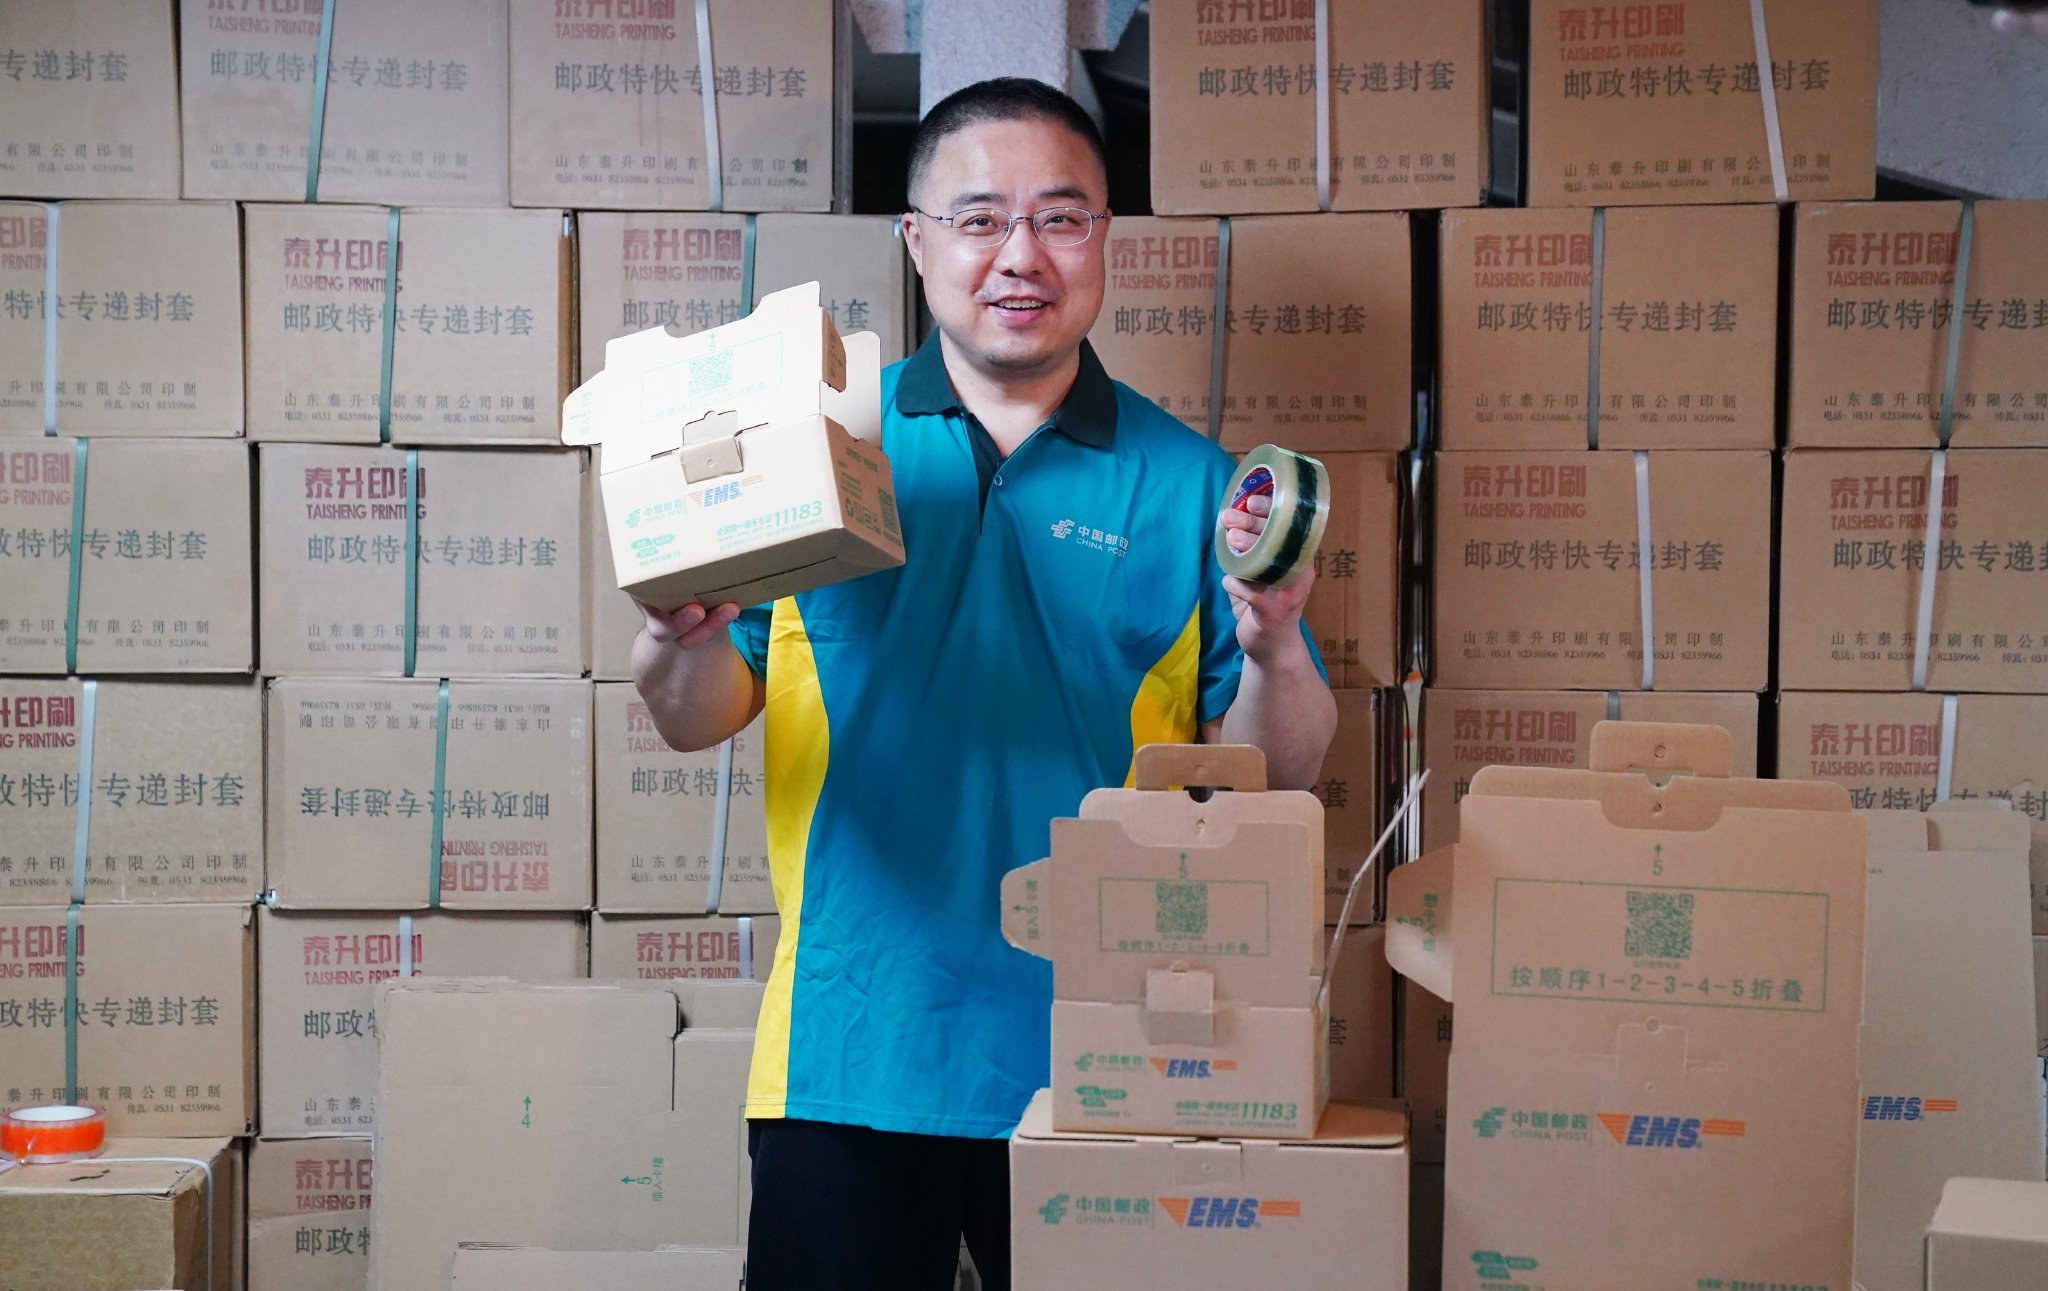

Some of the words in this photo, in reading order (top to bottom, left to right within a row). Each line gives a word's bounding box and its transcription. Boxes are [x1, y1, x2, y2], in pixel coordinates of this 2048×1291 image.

[274, 18, 321, 37] PRINTIN
[555, 23, 615, 40] TAISHENG
[619, 24, 676, 42] PRINTING
[1557, 4, 1685, 42] 泰升印刷
[1198, 27, 1258, 47] TAISHENG
[1262, 25, 1317, 44] PRINTING
[1558, 43, 1622, 62] TAISHENG
[1626, 40, 1685, 60] PRINTING
[555, 61, 807, 99] 邮政特快专递封套
[1198, 58, 1456, 97] 邮政特快专递封套
[1562, 57, 1831, 100] 邮政特快专递封套
[555, 153, 808, 175] 山东泰升印刷有公司印制
[1563, 152, 1832, 178] 山东泰升印刷有限公印制
[284, 238, 404, 271] 泰升印刷
[622, 228, 742, 262] 泰升印刷
[1473, 234, 1592, 268] 泰升印刷
[1827, 231, 1960, 266] 泰升印刷
[1, 254, 47, 270] PRINTIN
[623, 265, 683, 282] TAISHENG
[687, 265, 742, 282] PRINTING
[1112, 273, 1171, 290] TAISHENG
[1473, 271, 1536, 288] TAISHENG
[1827, 270, 1891, 287] TAISHENG
[1895, 269, 1955, 287] PRINTING
[284, 274, 344, 291] TAISHENG
[348, 276, 404, 293] PRINTIG
[1475, 393, 1737, 409] 山东泰升印有限公司印制
[305, 467, 427, 499] 泰升印刷
[1463, 464, 1587, 498] 泰升印刷
[14, 489, 71, 507] PRINTING
[703, 480, 741, 508] EMS
[1830, 474, 1960, 510] 泰升印刷
[306, 504, 367, 520] TAISHENG
[774, 500, 823, 528] 11183
[1463, 502, 1525, 519] TAISHENG
[1529, 502, 1586, 519] PRINTING
[1830, 513, 1894, 531] TAISHENG
[1078, 525, 1129, 550] 中国邮政
[1076, 537, 1103, 551] CHINA
[1107, 546, 1127, 558] POST
[1463, 630, 1724, 645] 山东泰升印刷有限司印制
[1453, 708, 1577, 743] 泰升印刷
[18, 732, 76, 748] PRINTING
[1810, 723, 1940, 757] 泰升印刷
[1453, 745, 1514, 763] TAISHENG
[1518, 746, 1576, 764] PRINTING
[1811, 760, 1874, 777] TAISHENG
[1879, 761, 1939, 777] PRINTING
[441, 839, 486, 857] PRINTIN
[490, 840, 549, 857] TAISHENG
[1652, 860, 1662, 876] 5
[28, 962, 85, 979] PRINTIG
[304, 970, 364, 985] TAISHENG
[637, 967, 697, 980] TAISHENG
[1509, 965, 1805, 1004] 按顺序1-2-3-4-5折叠
[1166, 1059, 1210, 1078] EMS
[1239, 1103, 1298, 1120] 11183
[1863, 1096, 1923, 1121] EMS
[520, 1113, 532, 1128] 4
[1511, 1110, 1590, 1131] 中国邮政
[1511, 1130, 1552, 1141] CHINA
[1555, 1131, 1589, 1142] POST
[1626, 1115, 1702, 1148] EMS
[296, 1195, 356, 1211] TAISHENG
[1075, 1196, 1151, 1214] 中国邮政
[1186, 1196, 1258, 1229] EMS
[1076, 1215, 1116, 1225] CHINA
[1120, 1216, 1150, 1226] POST
